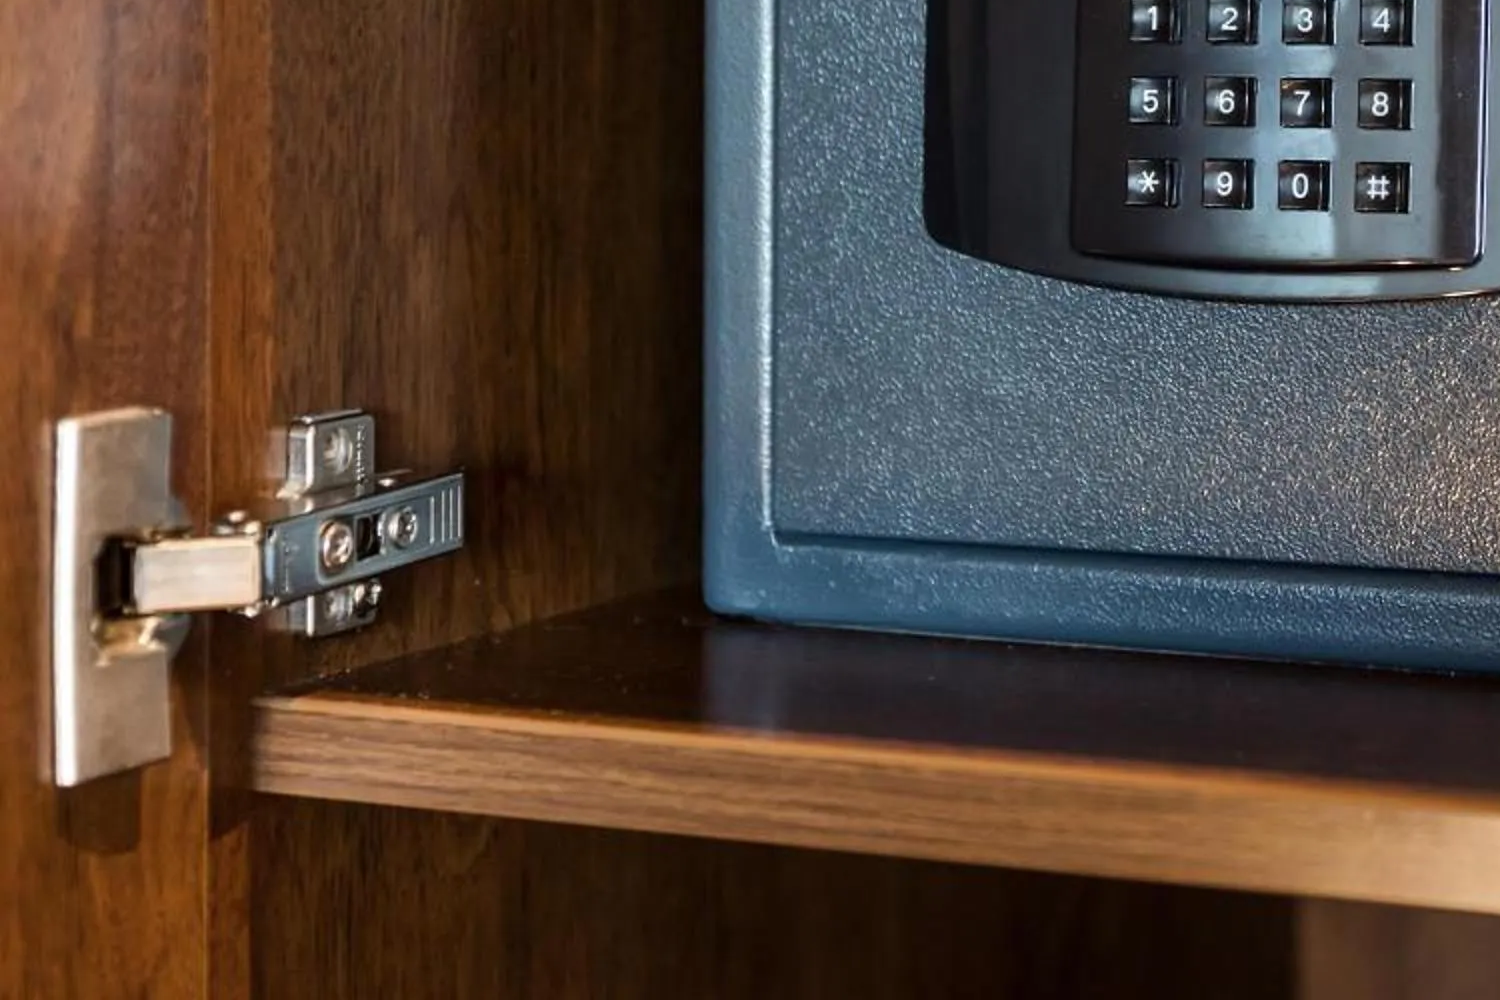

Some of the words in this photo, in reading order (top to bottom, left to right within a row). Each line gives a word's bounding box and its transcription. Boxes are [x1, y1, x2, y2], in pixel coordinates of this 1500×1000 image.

[1147, 5, 1159, 31] 1
[1220, 7, 1239, 31] 2
[1296, 7, 1314, 33] 3
[1372, 8, 1391, 33] 4
[1142, 89, 1159, 113] 5
[1219, 89, 1235, 114] 6
[1295, 90, 1310, 116] 7
[1371, 91, 1389, 117] 8
[1217, 172, 1233, 196] 9
[1292, 173, 1309, 199] 0
[1367, 175, 1390, 200] #
